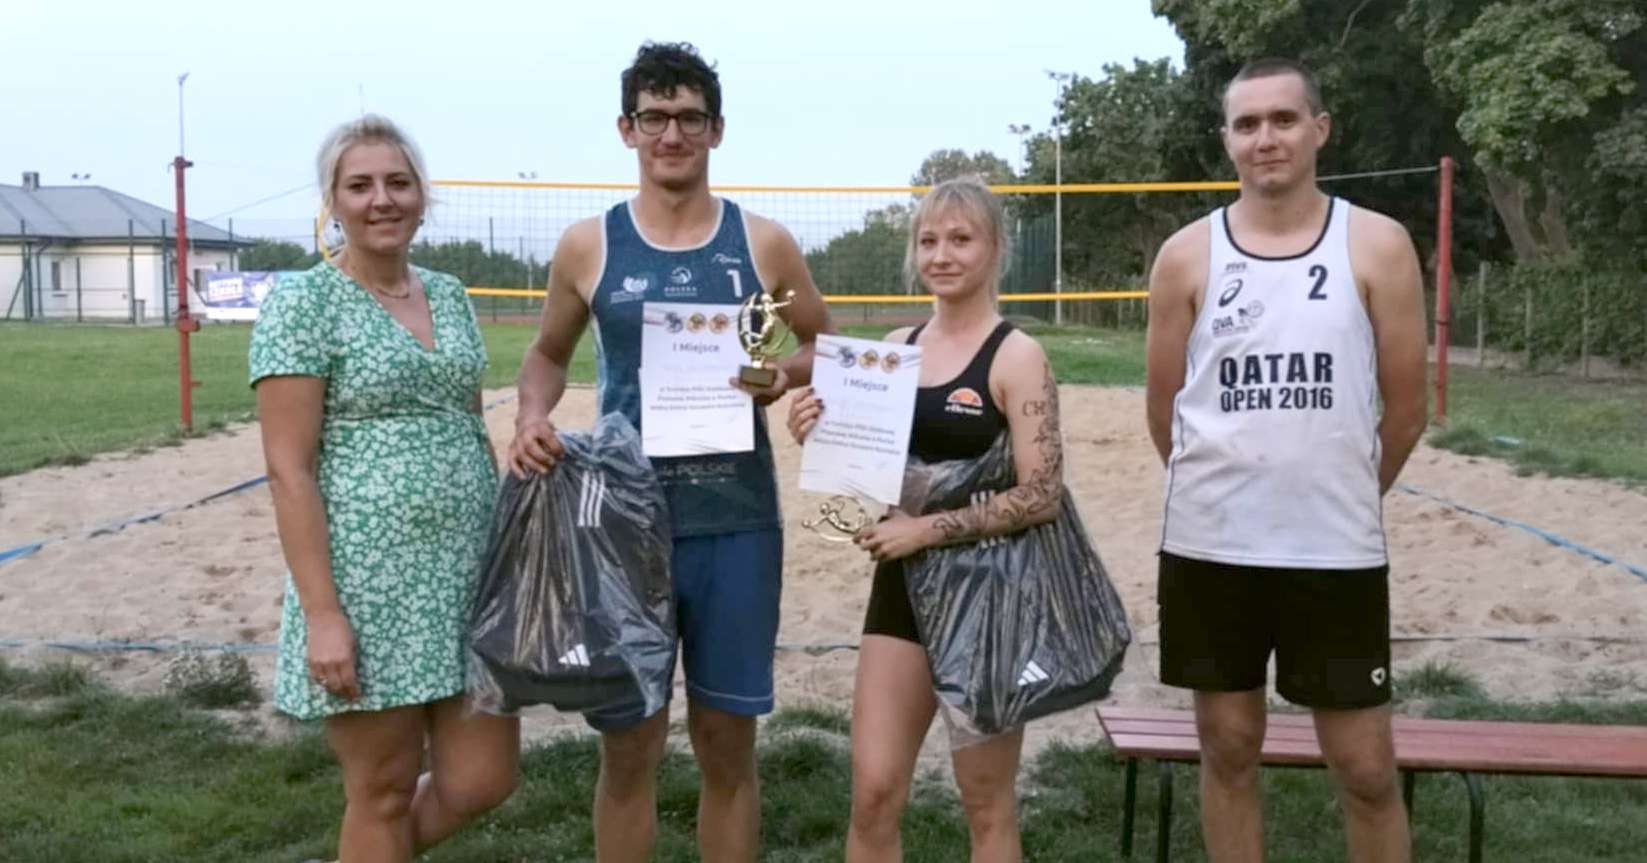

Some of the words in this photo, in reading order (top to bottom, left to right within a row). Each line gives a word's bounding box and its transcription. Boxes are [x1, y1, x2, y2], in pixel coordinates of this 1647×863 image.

[726, 269, 743, 298] 1
[1308, 264, 1328, 300] 2
[679, 342, 719, 354] Miejsce
[1219, 352, 1334, 390] QATAR
[850, 379, 889, 392] Miejsce
[1220, 387, 1272, 413] OPEN
[1279, 387, 1333, 410] 2016
